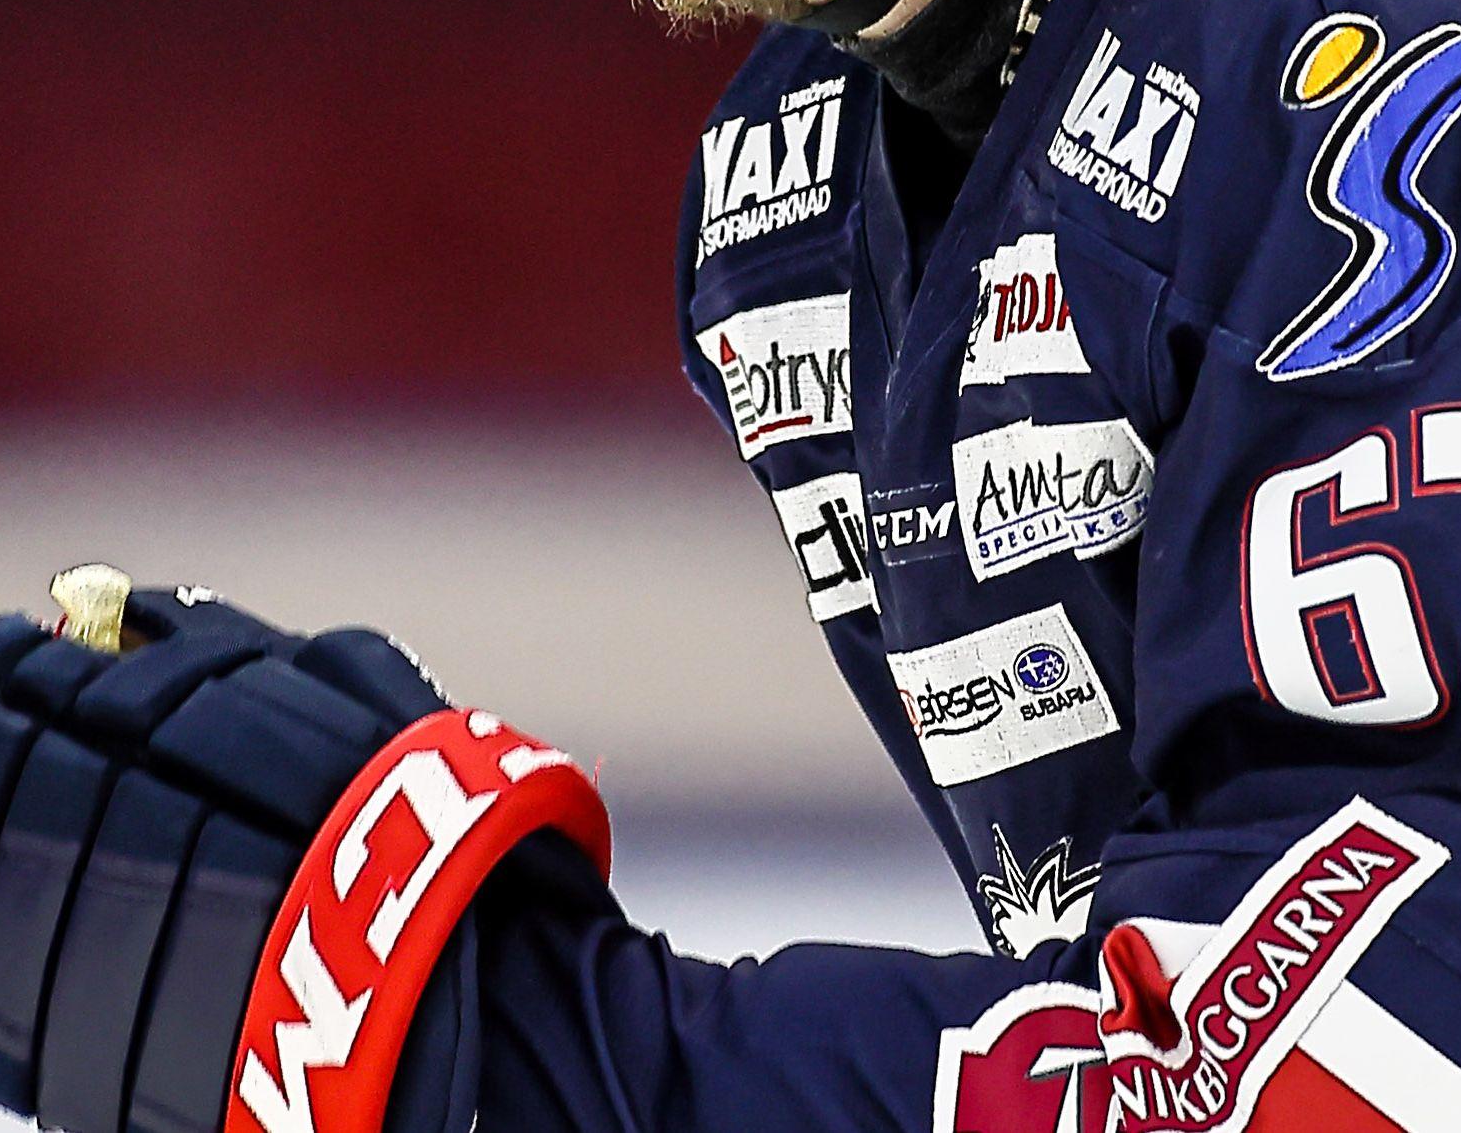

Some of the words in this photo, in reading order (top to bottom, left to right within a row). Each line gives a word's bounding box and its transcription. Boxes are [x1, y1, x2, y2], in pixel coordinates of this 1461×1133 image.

[972, 451, 1143, 538] Amta
[871, 500, 957, 550] CCM
[1019, 682, 1097, 722] SUBARU
